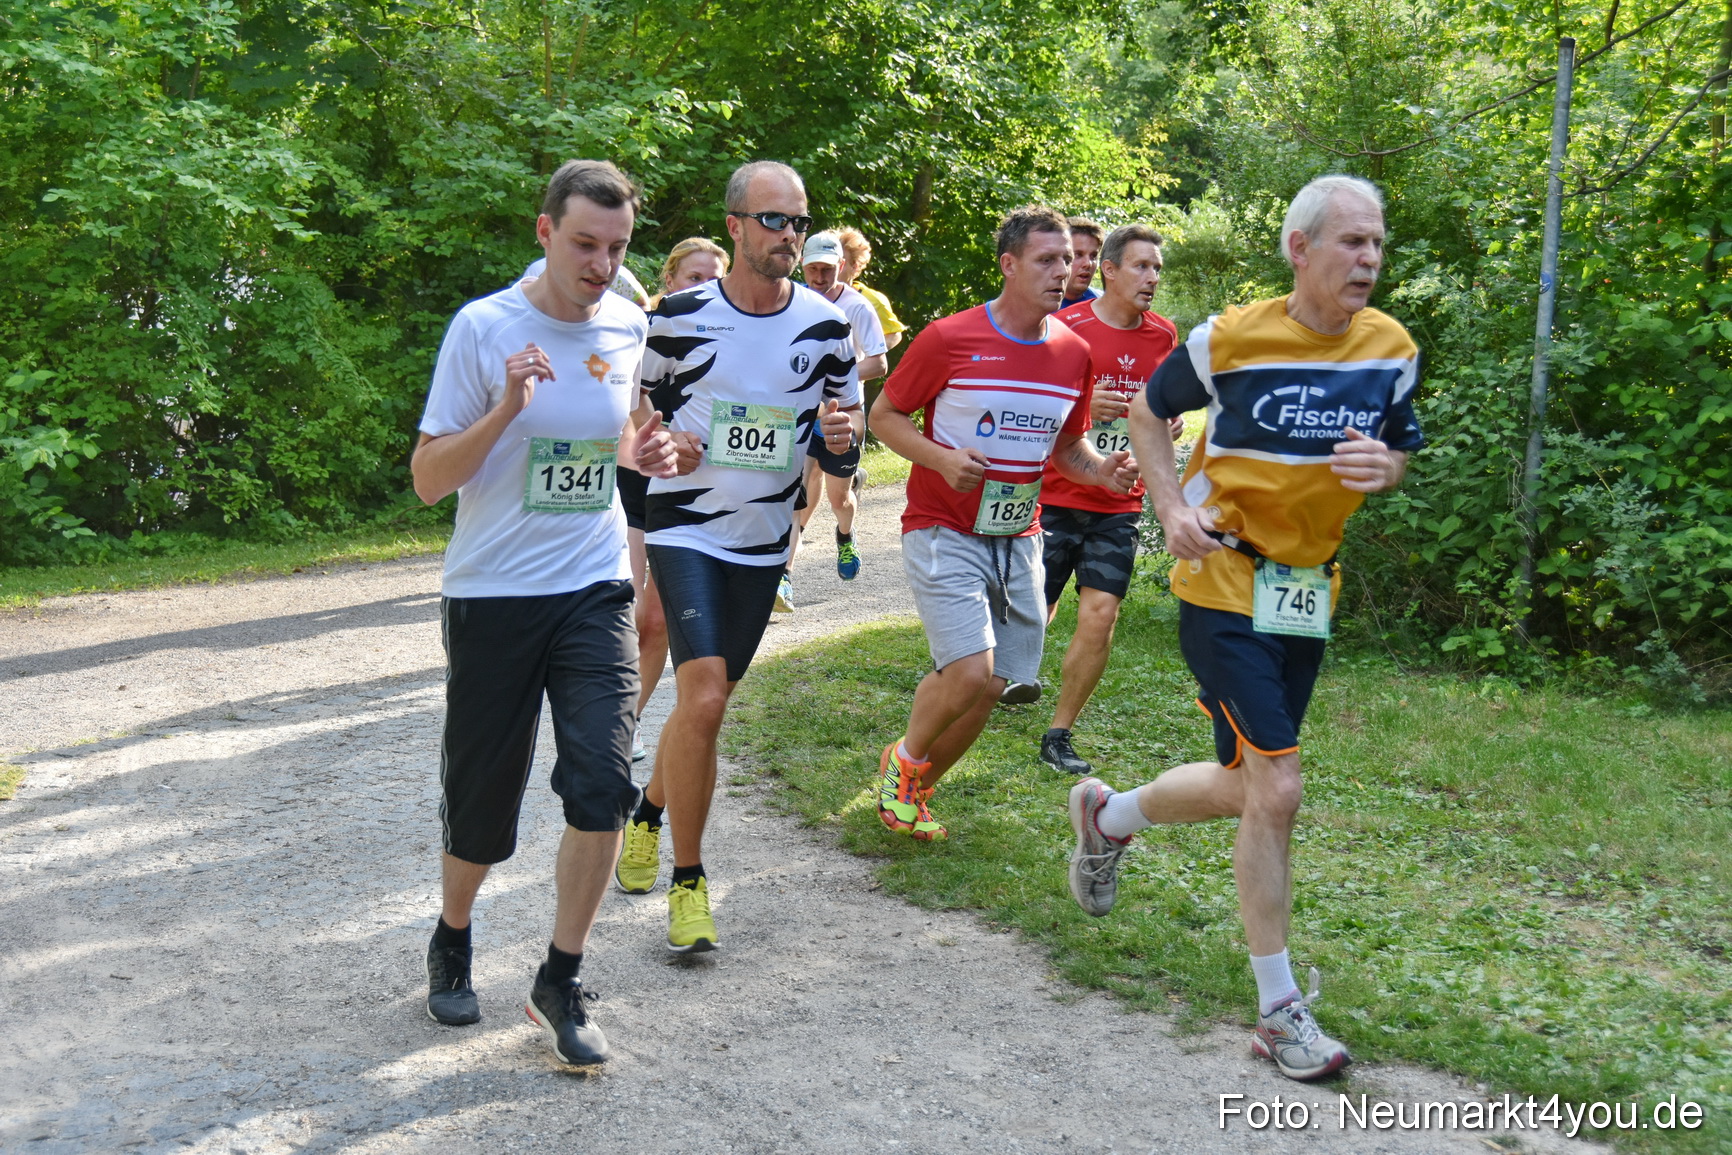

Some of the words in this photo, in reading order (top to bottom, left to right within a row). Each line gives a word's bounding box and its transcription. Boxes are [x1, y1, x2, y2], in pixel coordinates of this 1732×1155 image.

[1000, 410, 1060, 434] Petry
[1277, 405, 1381, 426] Fischer
[727, 426, 776, 452] 804
[999, 433, 1021, 442] WÄRME
[1022, 435, 1041, 443] KÄLTE
[1096, 432, 1130, 452] 612
[726, 450, 759, 459] Zibrowius
[760, 452, 776, 460] Marc
[540, 464, 605, 492] 1341
[551, 492, 573, 501] König
[574, 492, 595, 500] Stefan
[990, 499, 1034, 521] 1829
[1274, 586, 1316, 616] 746
[1275, 613, 1300, 622] Fischer
